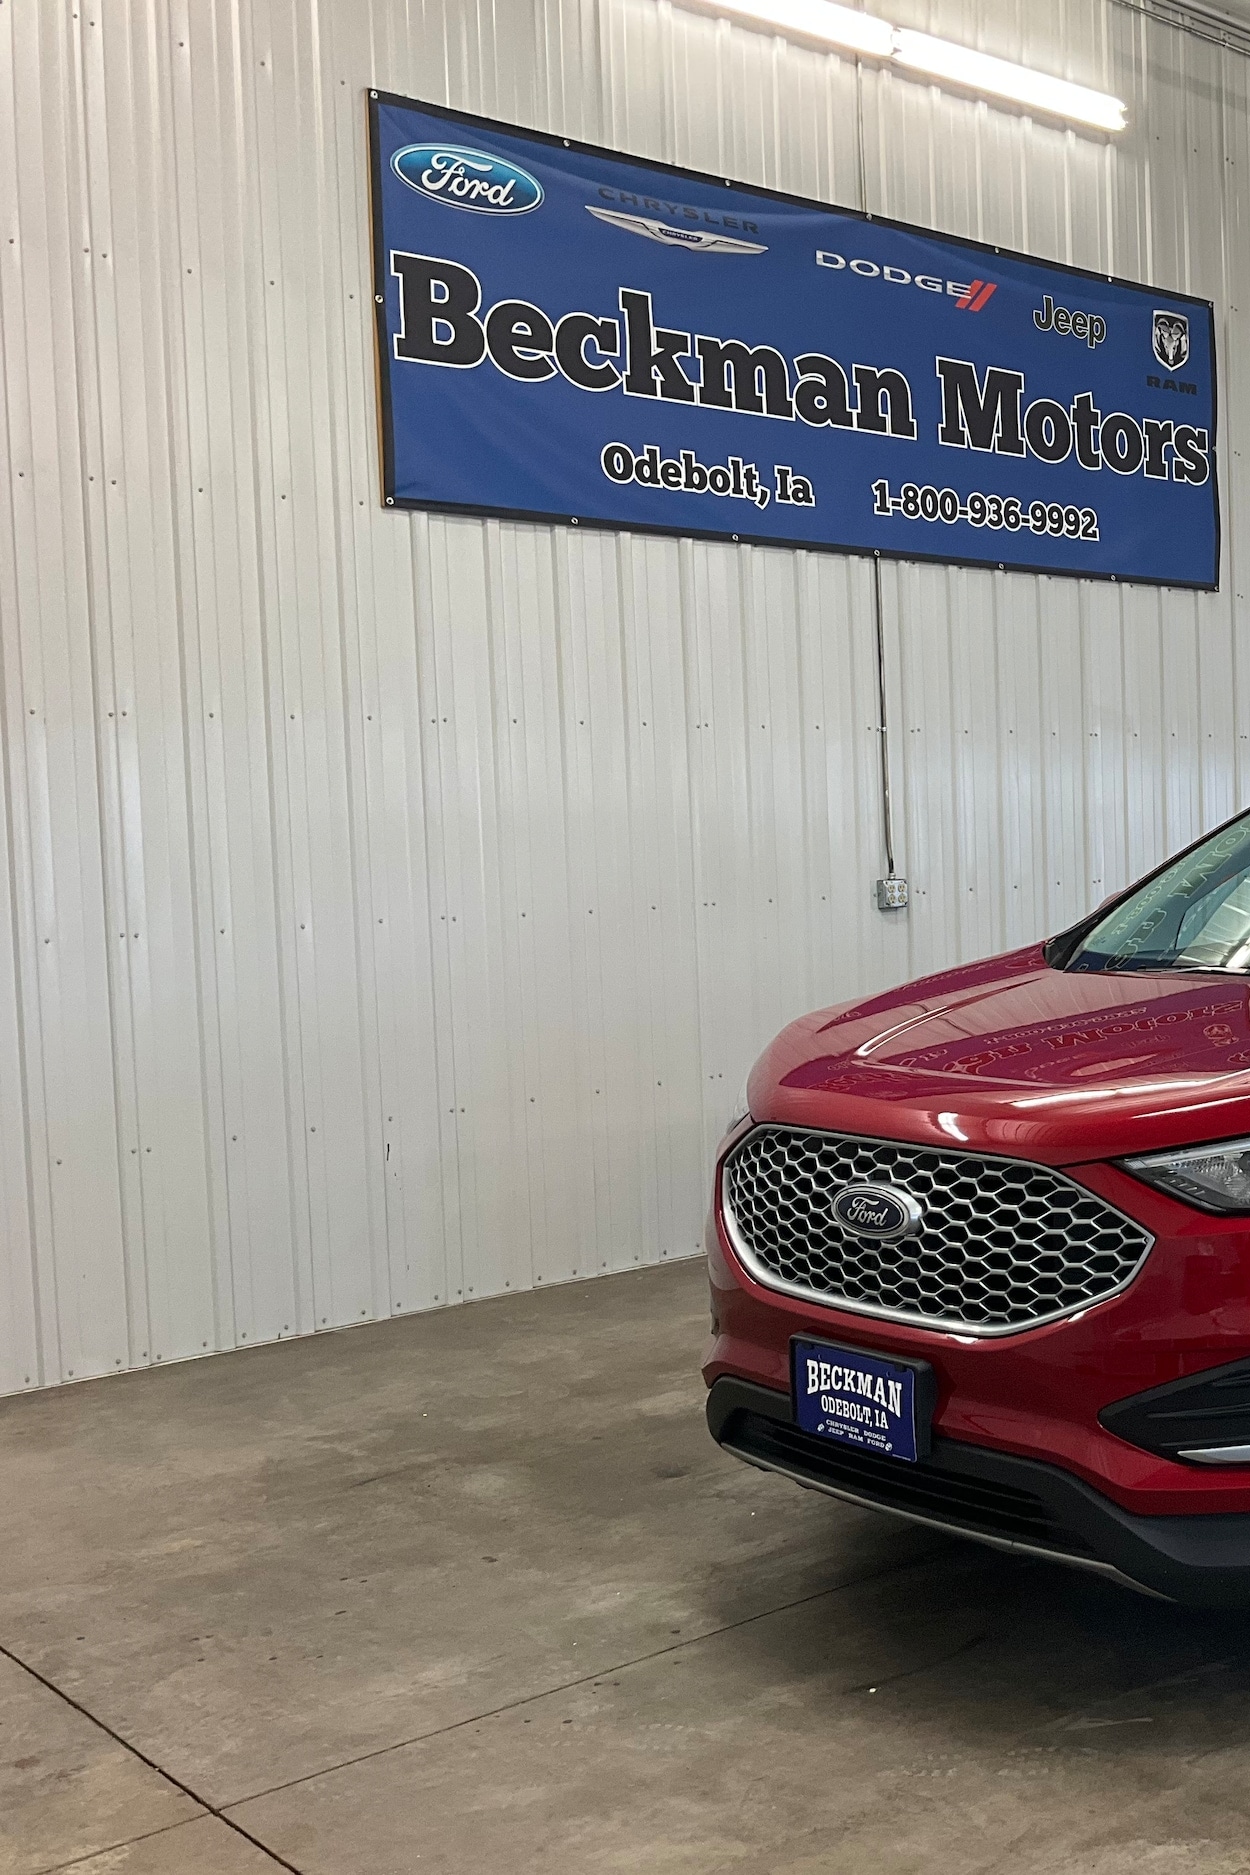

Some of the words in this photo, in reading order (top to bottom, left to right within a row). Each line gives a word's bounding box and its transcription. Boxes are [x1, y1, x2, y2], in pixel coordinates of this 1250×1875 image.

[420, 151, 516, 208] Ford
[598, 187, 760, 235] CHRYSLER
[814, 250, 974, 299] DODGE
[1033, 295, 1107, 348] Jeep
[389, 249, 918, 440] Beckman
[935, 355, 1210, 486] Motors
[1146, 375, 1198, 396] RAM
[600, 441, 771, 510] Odebolt,
[774, 464, 816, 508] Ia
[871, 478, 1100, 542] 1-800-936-9992
[847, 1197, 889, 1227] Ford
[806, 1359, 903, 1418] BECKMAN
[820, 1394, 873, 1428] ODEBOLT,
[874, 1409, 889, 1430] IA
[825, 1419, 860, 1434] CHRYSLER
[863, 1430, 887, 1442] DODGE
[828, 1427, 845, 1436] JEEP
[848, 1433, 864, 1443] RAM
[867, 1438, 885, 1449] FORD
